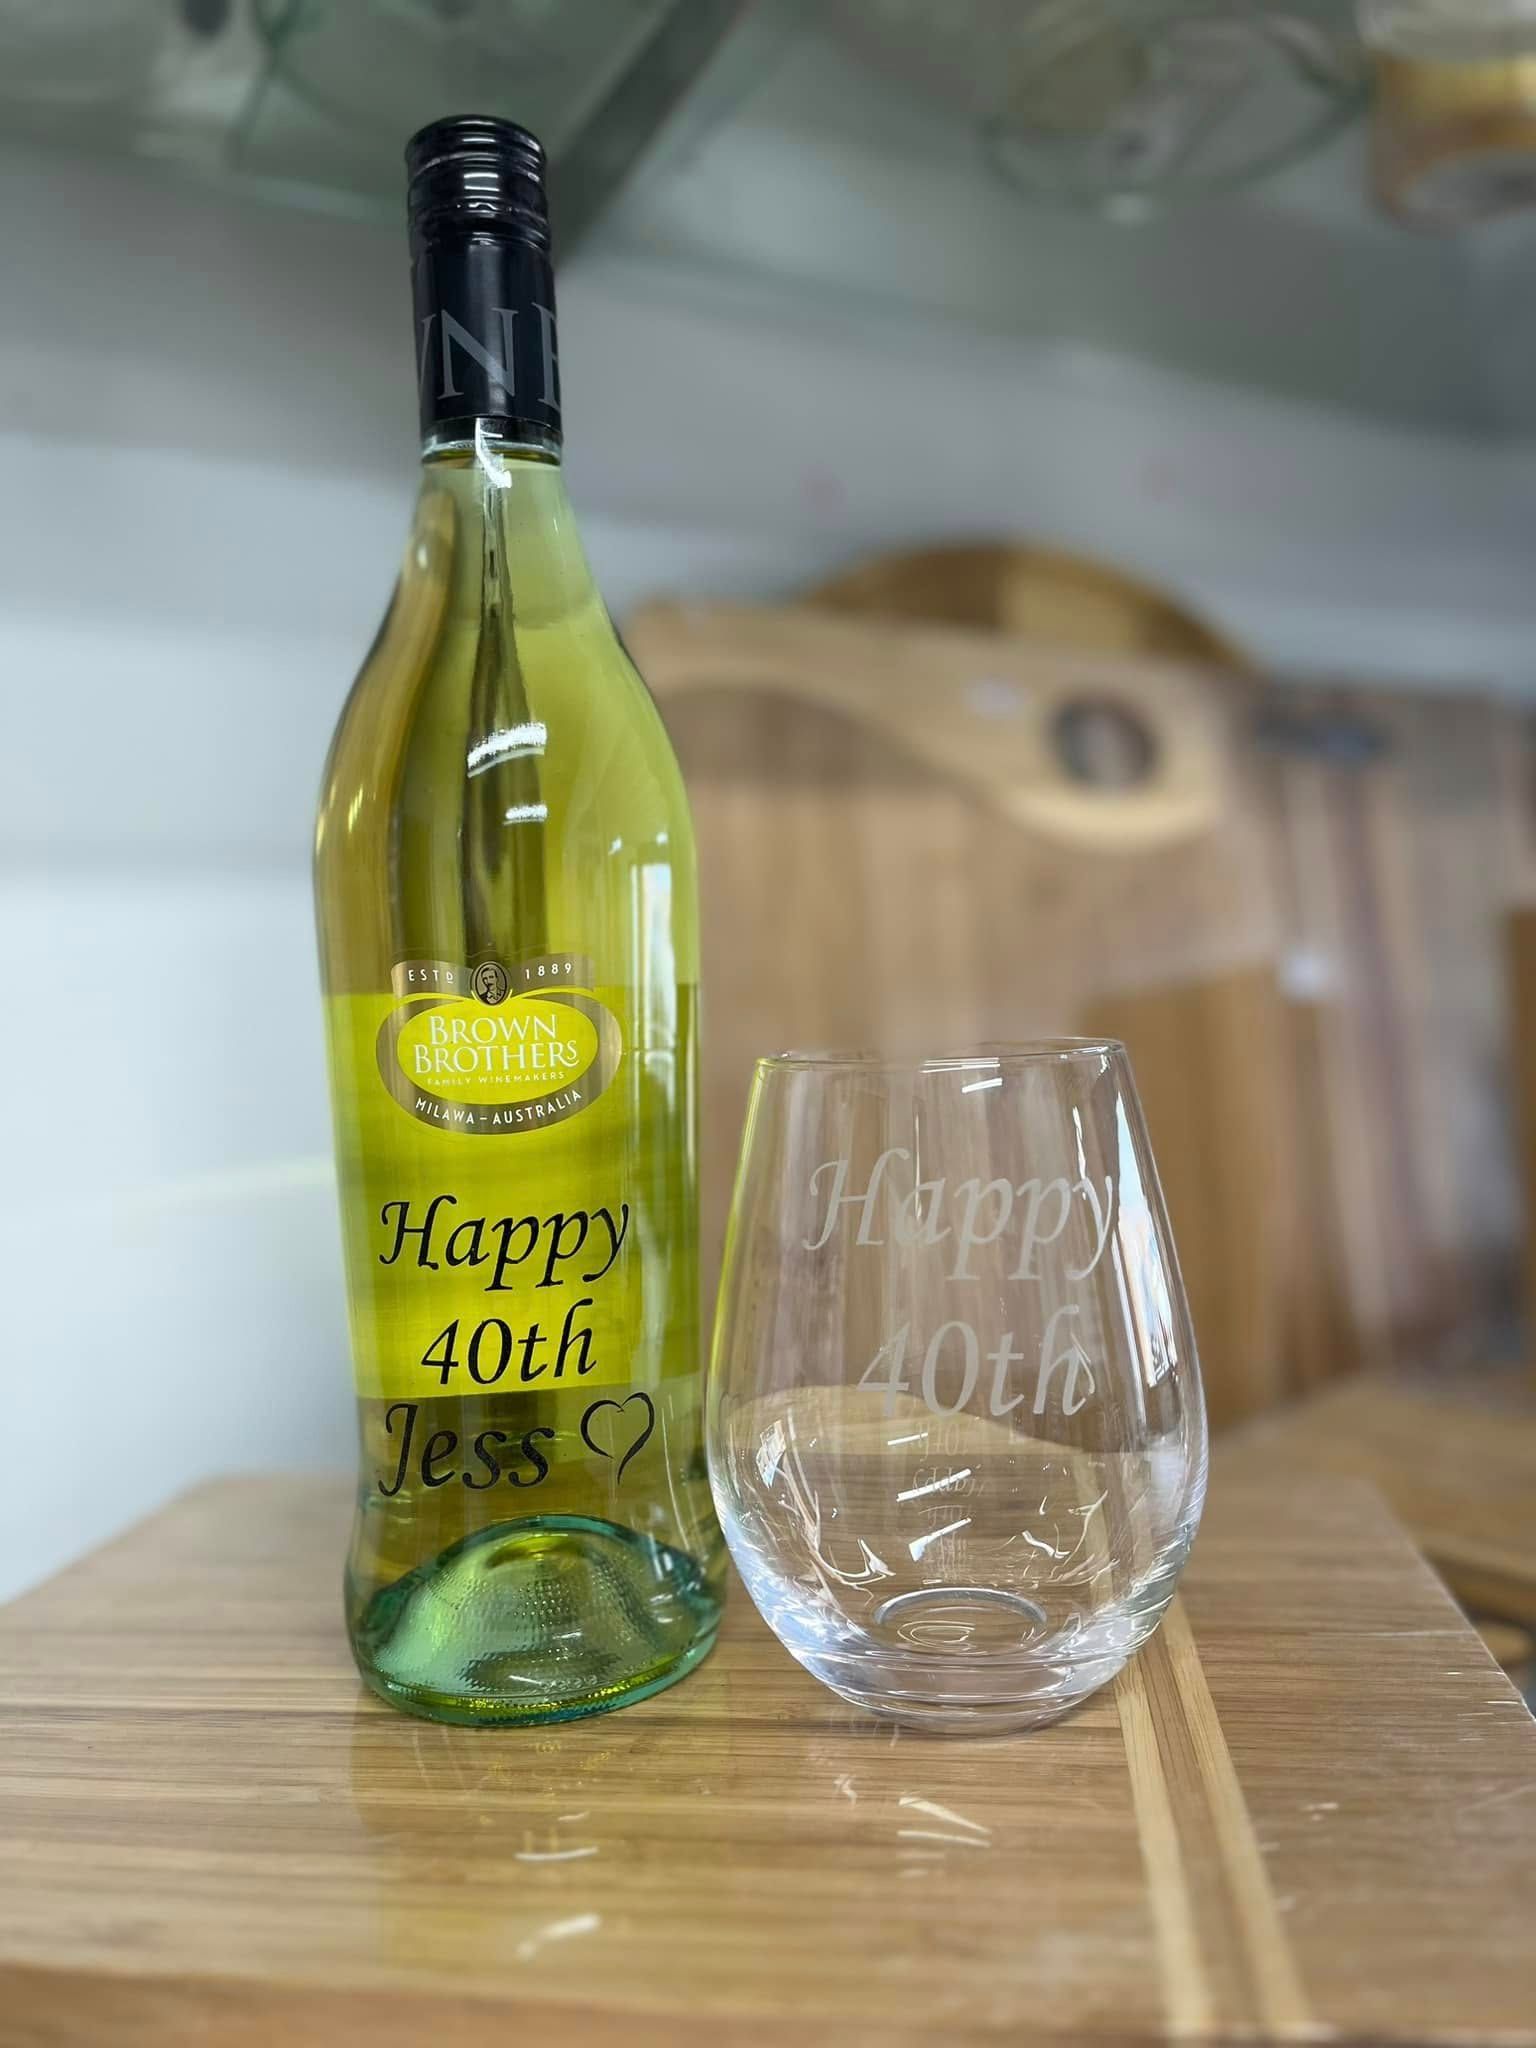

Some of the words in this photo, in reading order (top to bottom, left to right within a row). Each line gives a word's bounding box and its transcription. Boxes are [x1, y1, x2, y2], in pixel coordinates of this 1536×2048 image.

[525, 962, 573, 980] 1889
[415, 1096, 475, 1125] MILAWA
[492, 1088, 582, 1125] AUSTRALIA
[427, 1077, 472, 1086] FAMILY
[479, 1070, 566, 1084] WINEMAKERS
[378, 1195, 629, 1291] Happy
[801, 1147, 1113, 1281] Happy
[420, 1298, 597, 1385] 40th
[856, 1304, 1090, 1417] 40th
[377, 1403, 555, 1497] Jess
